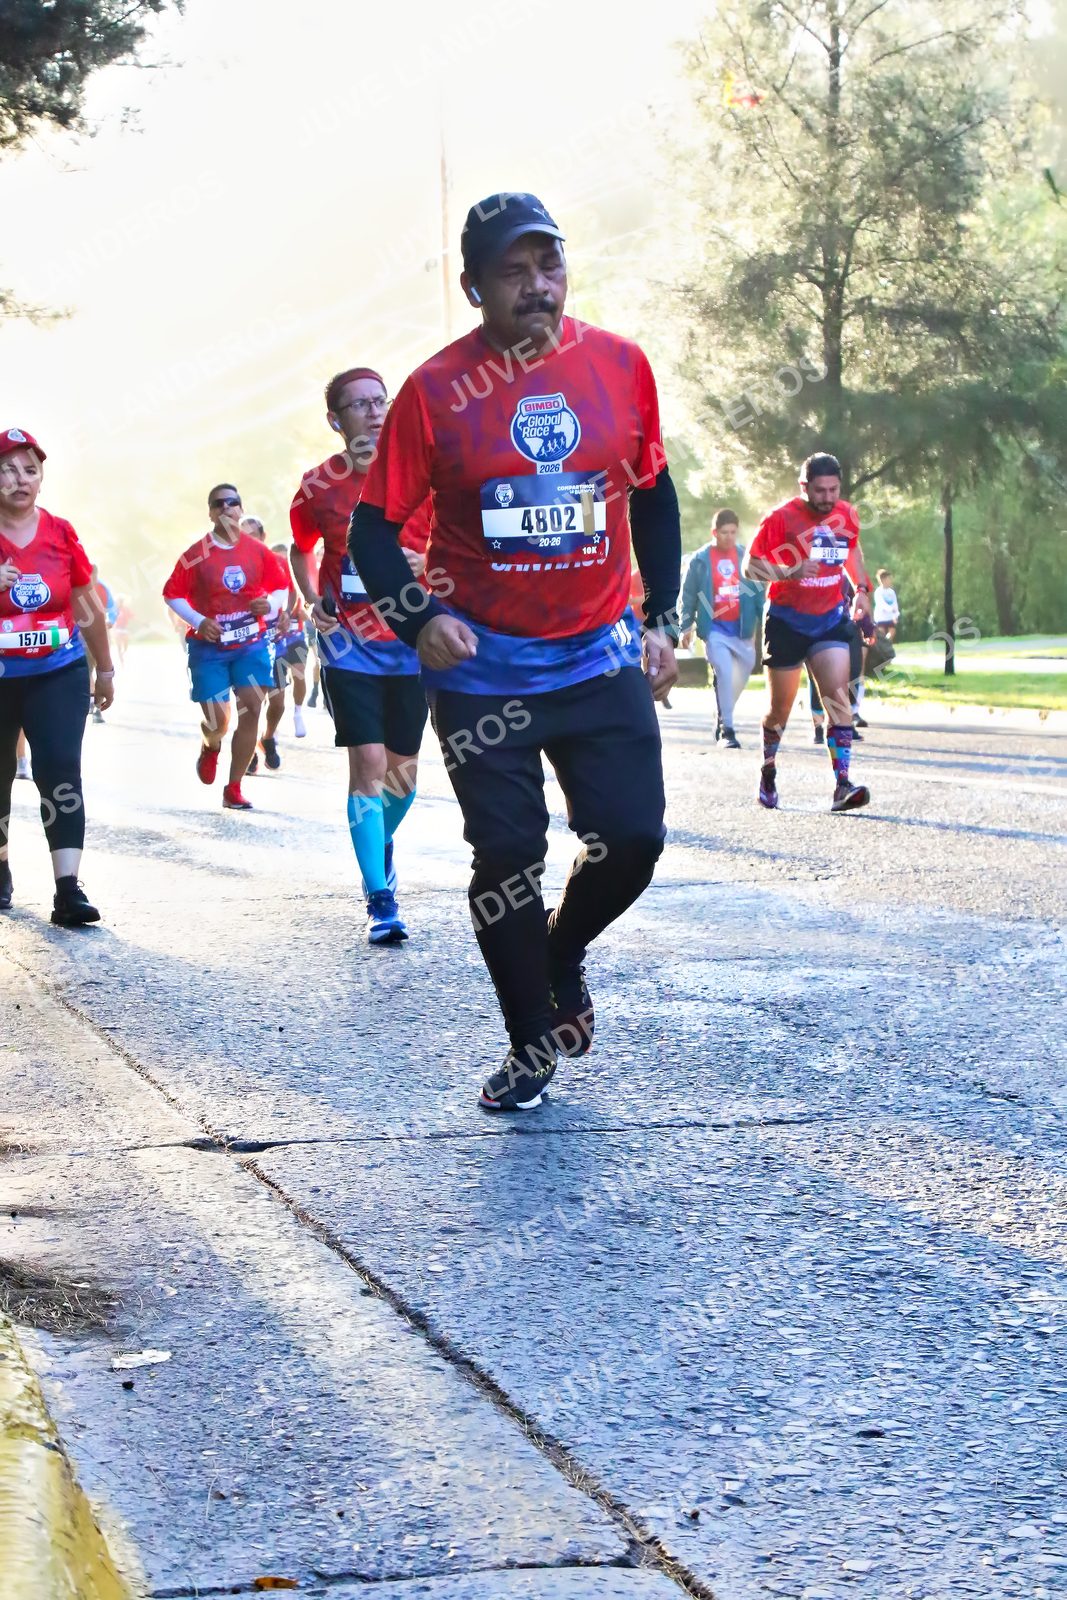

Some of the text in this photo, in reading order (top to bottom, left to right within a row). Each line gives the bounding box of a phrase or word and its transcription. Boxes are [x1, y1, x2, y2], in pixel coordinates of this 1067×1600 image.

[524, 400, 560, 412] BIMBO
[527, 412, 561, 427] Global
[522, 426, 550, 438] Race
[539, 463, 561, 474] 2026
[521, 506, 576, 534] 4802
[582, 546, 598, 555] 10K
[822, 548, 839, 558] 5105
[233, 627, 250, 638] 4520
[19, 632, 47, 646] 1570
